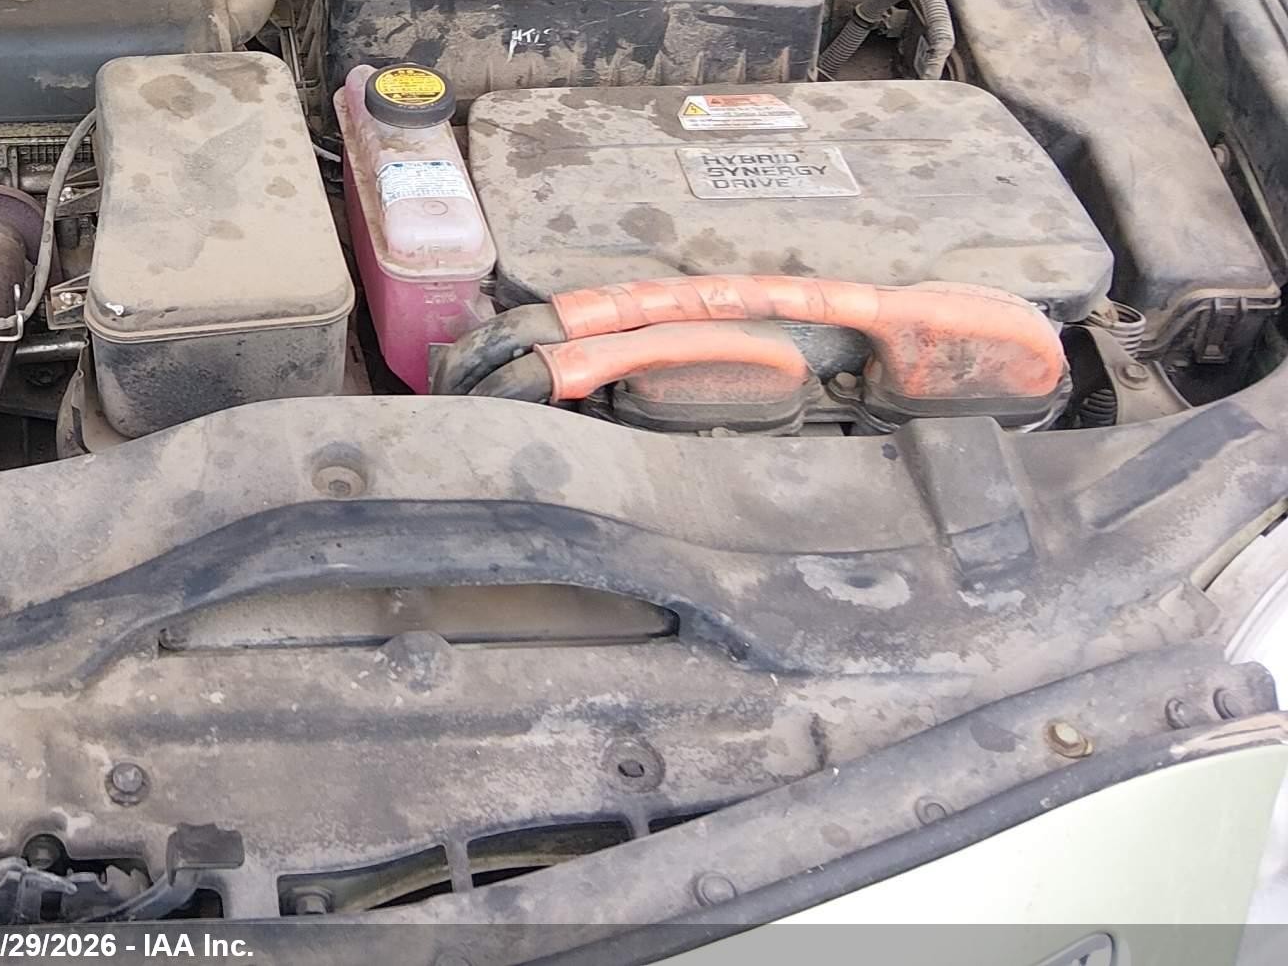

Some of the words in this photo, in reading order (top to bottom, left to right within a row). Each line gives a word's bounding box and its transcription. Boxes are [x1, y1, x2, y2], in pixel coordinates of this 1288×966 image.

[702, 153, 801, 166] HYBRID
[707, 165, 827, 177] SYNERGY
[713, 178, 791, 189] DRIVE
